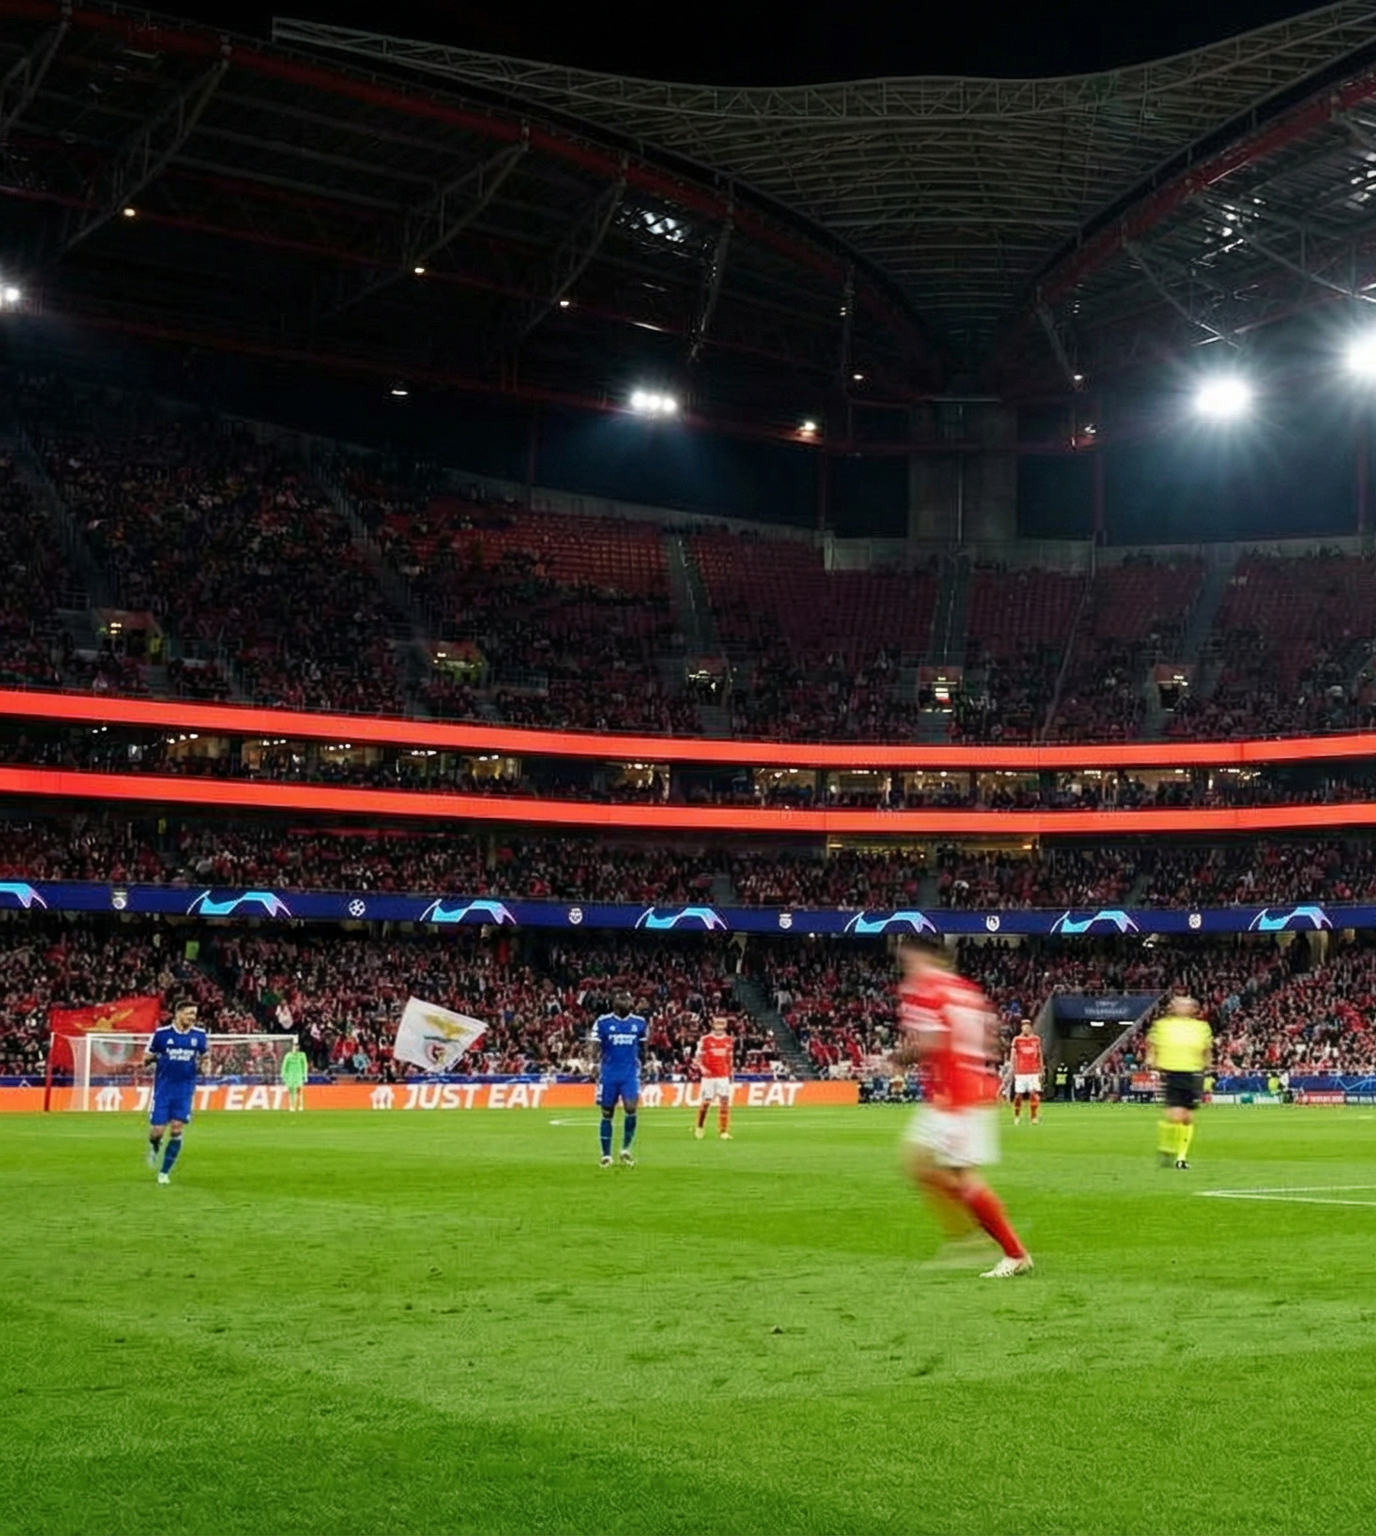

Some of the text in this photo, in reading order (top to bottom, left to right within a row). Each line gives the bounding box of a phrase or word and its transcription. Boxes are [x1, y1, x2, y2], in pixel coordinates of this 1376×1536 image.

[132, 1086, 287, 1110] JT EAT
[403, 1084, 547, 1109] JUST EAT
[671, 1083, 804, 1107] JUT EAT
